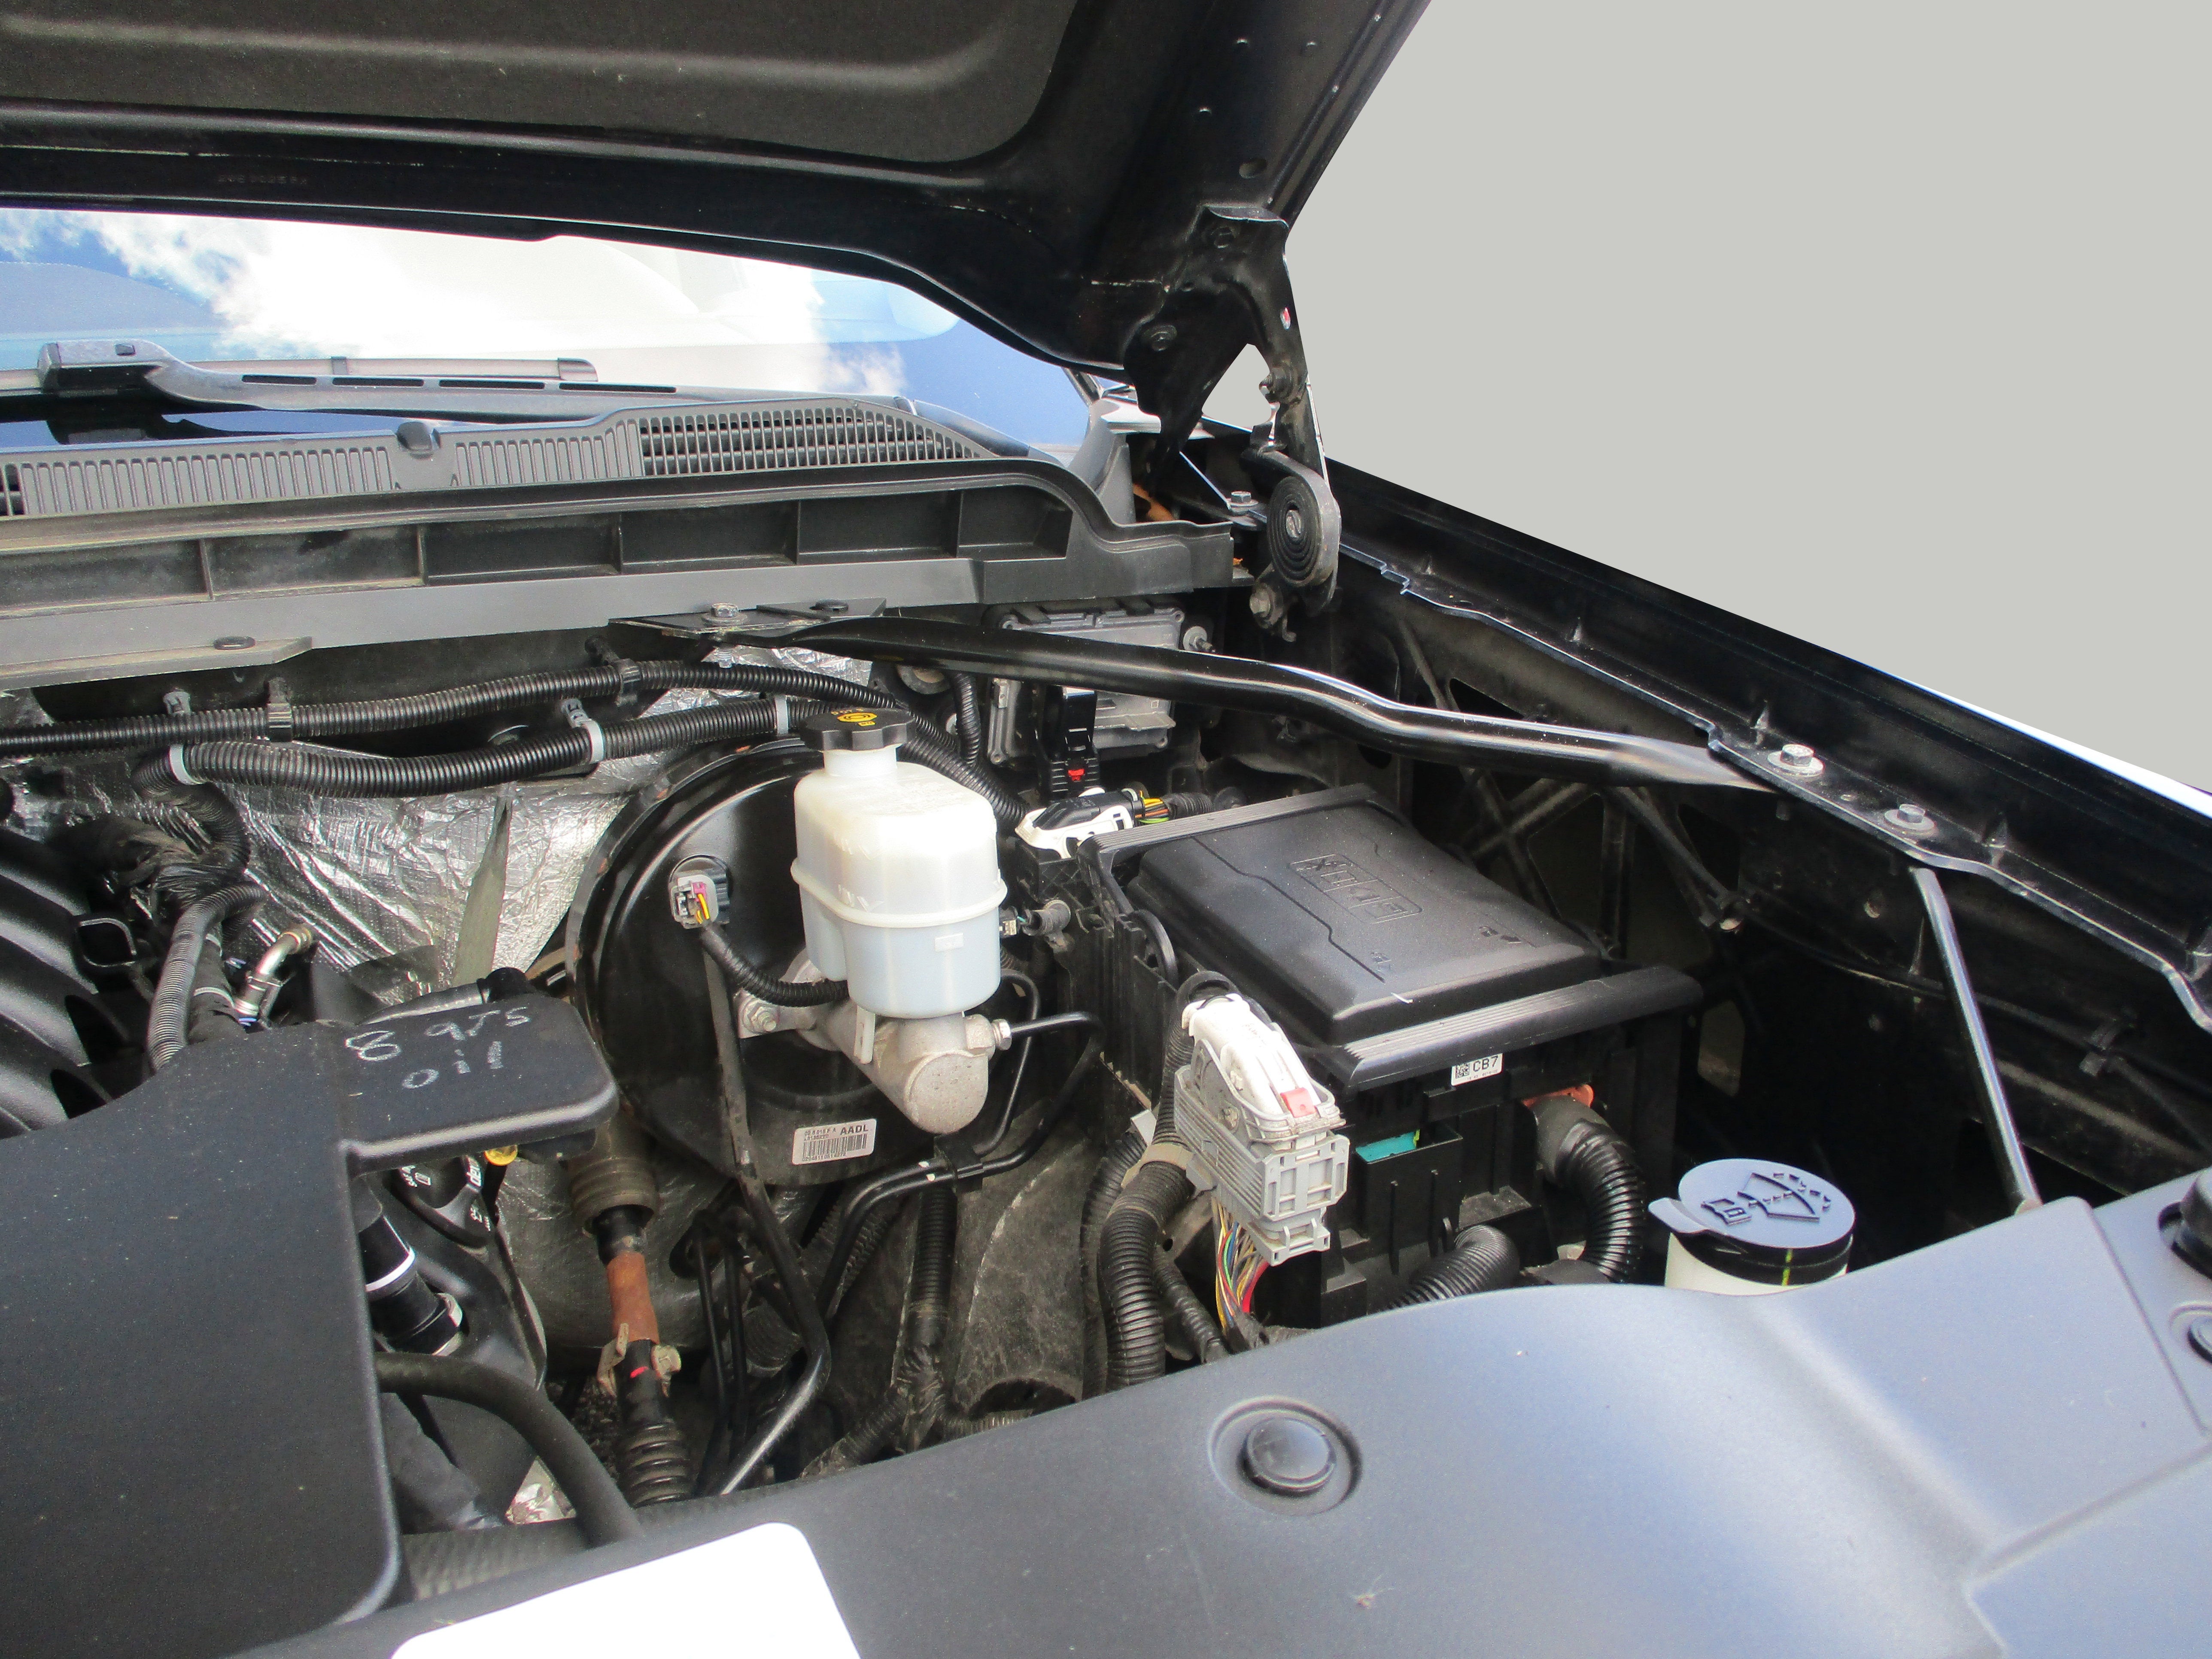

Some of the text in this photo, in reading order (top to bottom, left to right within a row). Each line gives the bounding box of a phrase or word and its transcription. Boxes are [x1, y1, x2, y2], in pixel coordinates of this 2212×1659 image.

[344, 1030, 402, 1062] 8
[1473, 1055, 1498, 1073] CB7
[840, 1124, 869, 1136] AADL
